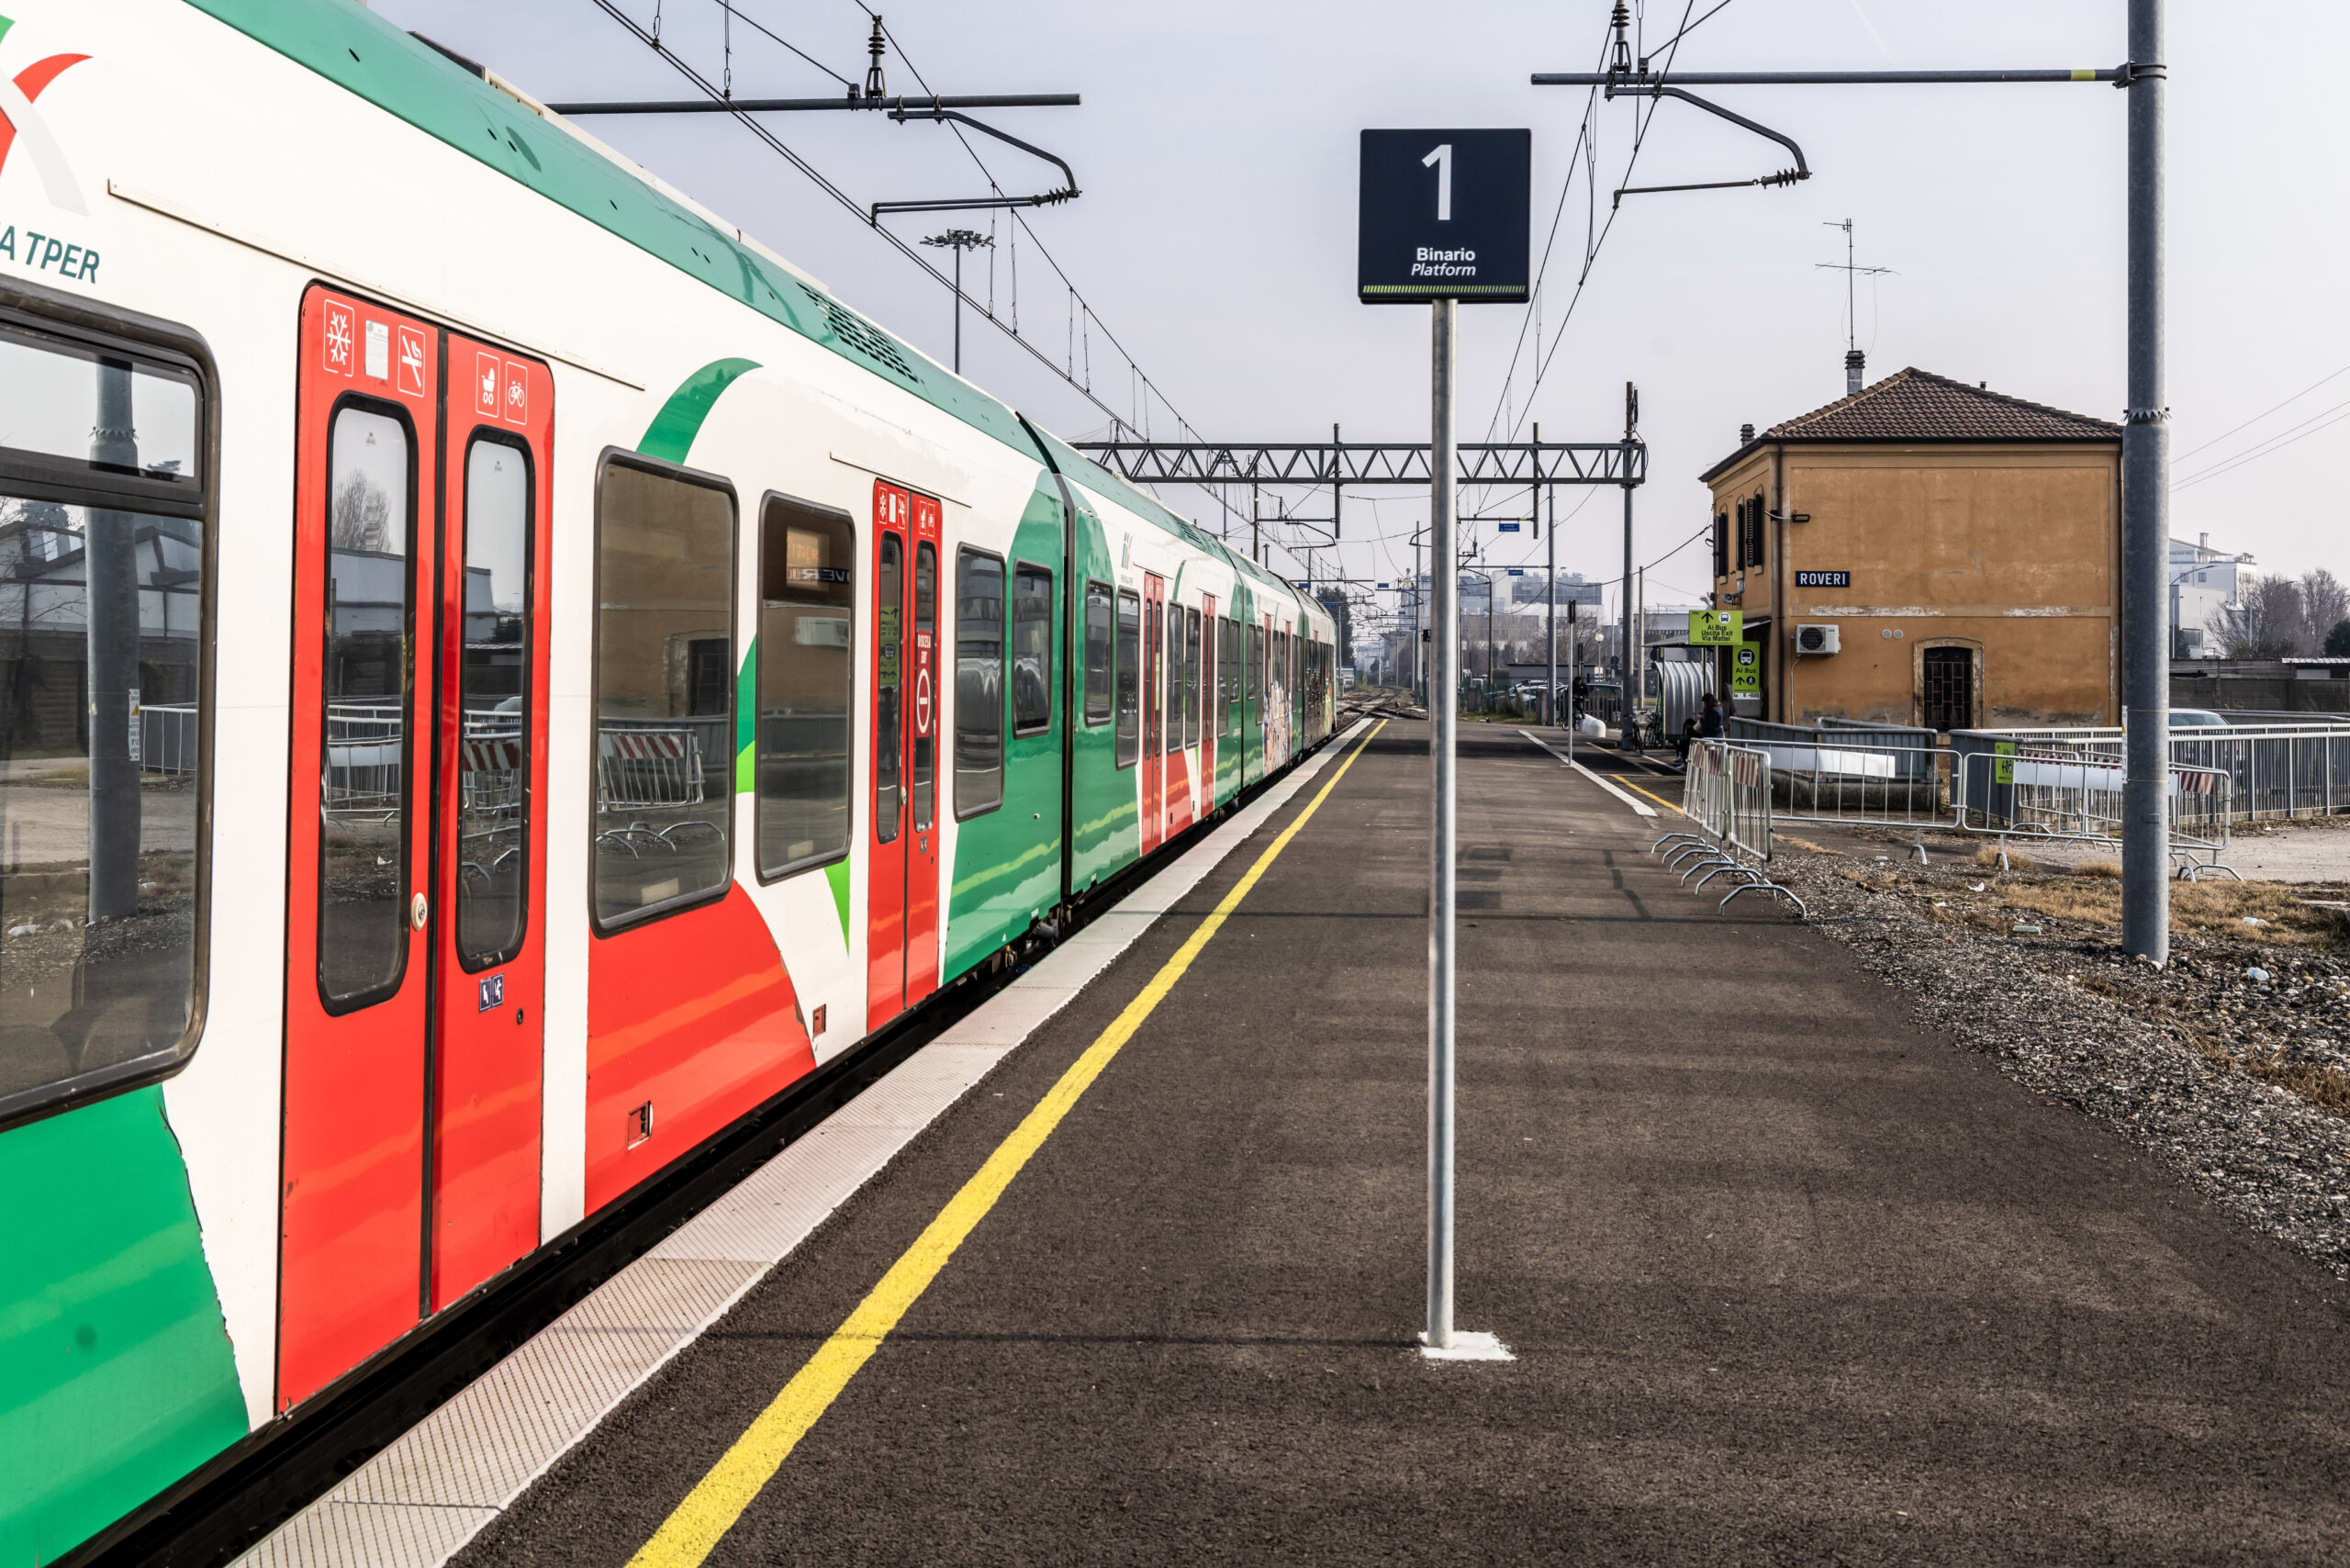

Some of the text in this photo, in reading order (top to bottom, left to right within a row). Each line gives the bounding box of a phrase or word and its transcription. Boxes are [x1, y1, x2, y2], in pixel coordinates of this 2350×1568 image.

[1421, 144, 1452, 220] 1
[26, 230, 100, 284] TPER
[1416, 247, 1476, 262] Binario
[1411, 263, 1477, 276] Platform
[1800, 573, 1846, 585] ROVERI
